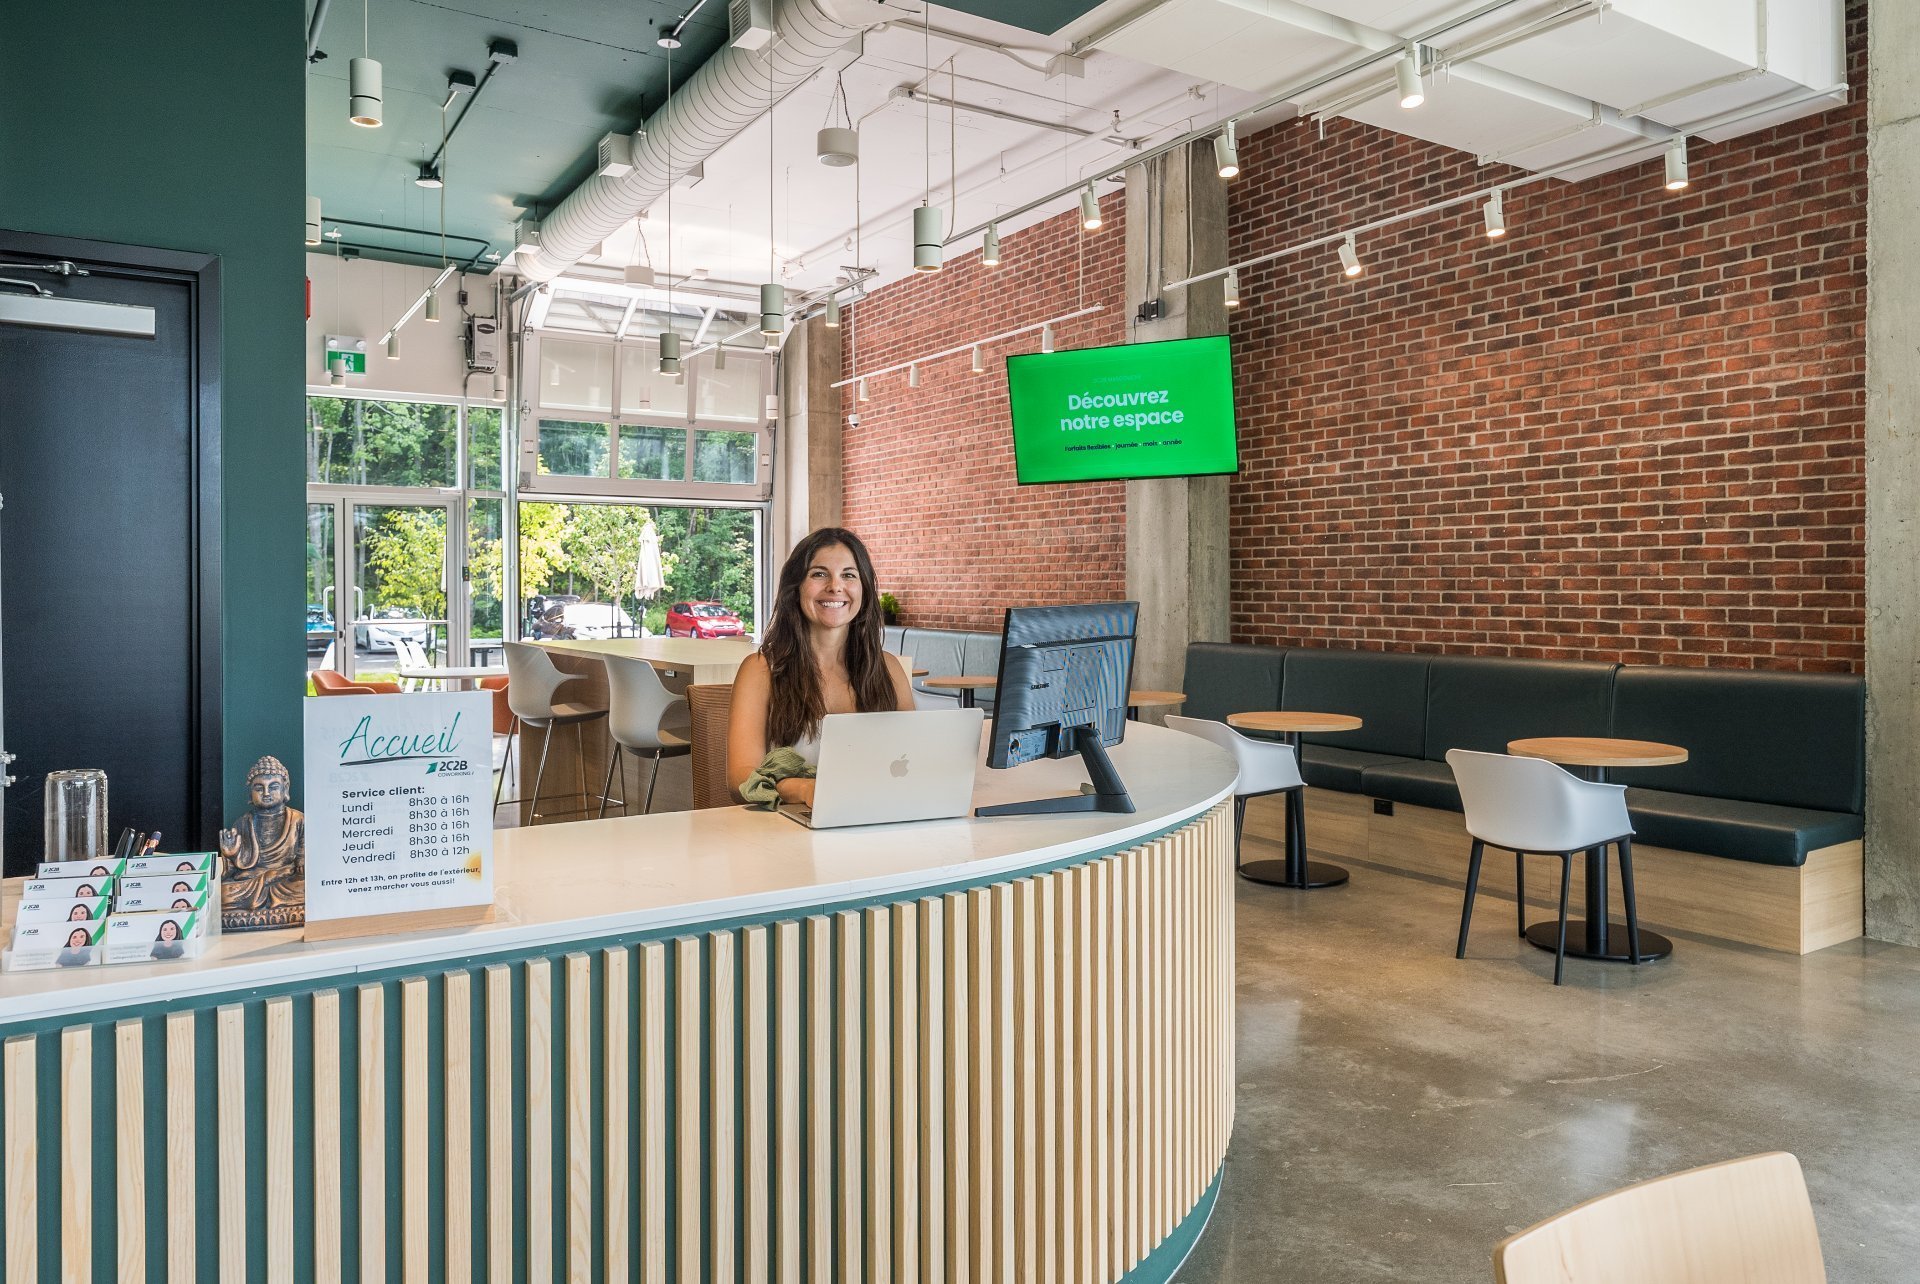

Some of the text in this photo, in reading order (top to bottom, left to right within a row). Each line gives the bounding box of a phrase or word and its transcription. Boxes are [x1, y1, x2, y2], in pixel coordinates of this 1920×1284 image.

[1068, 390, 1169, 411] Découvrez
[1060, 410, 1184, 431] notre espace
[339, 711, 462, 759] Accueil
[439, 760, 468, 771] 2C2B
[342, 786, 425, 799] Service client:
[342, 795, 470, 813] Lundi 8h30 à 16h
[342, 807, 470, 826] Mardi 8h30 à 16h
[342, 820, 470, 839] Mercredi 8h30 à 16h
[342, 833, 470, 852] Jeudi 8h30 à 16h
[342, 846, 470, 864] Vendredi 8h30 à 12h
[374, 883, 409, 891] marcher
[431, 878, 455, 886] aussi!
[400, 871, 426, 880] profite
